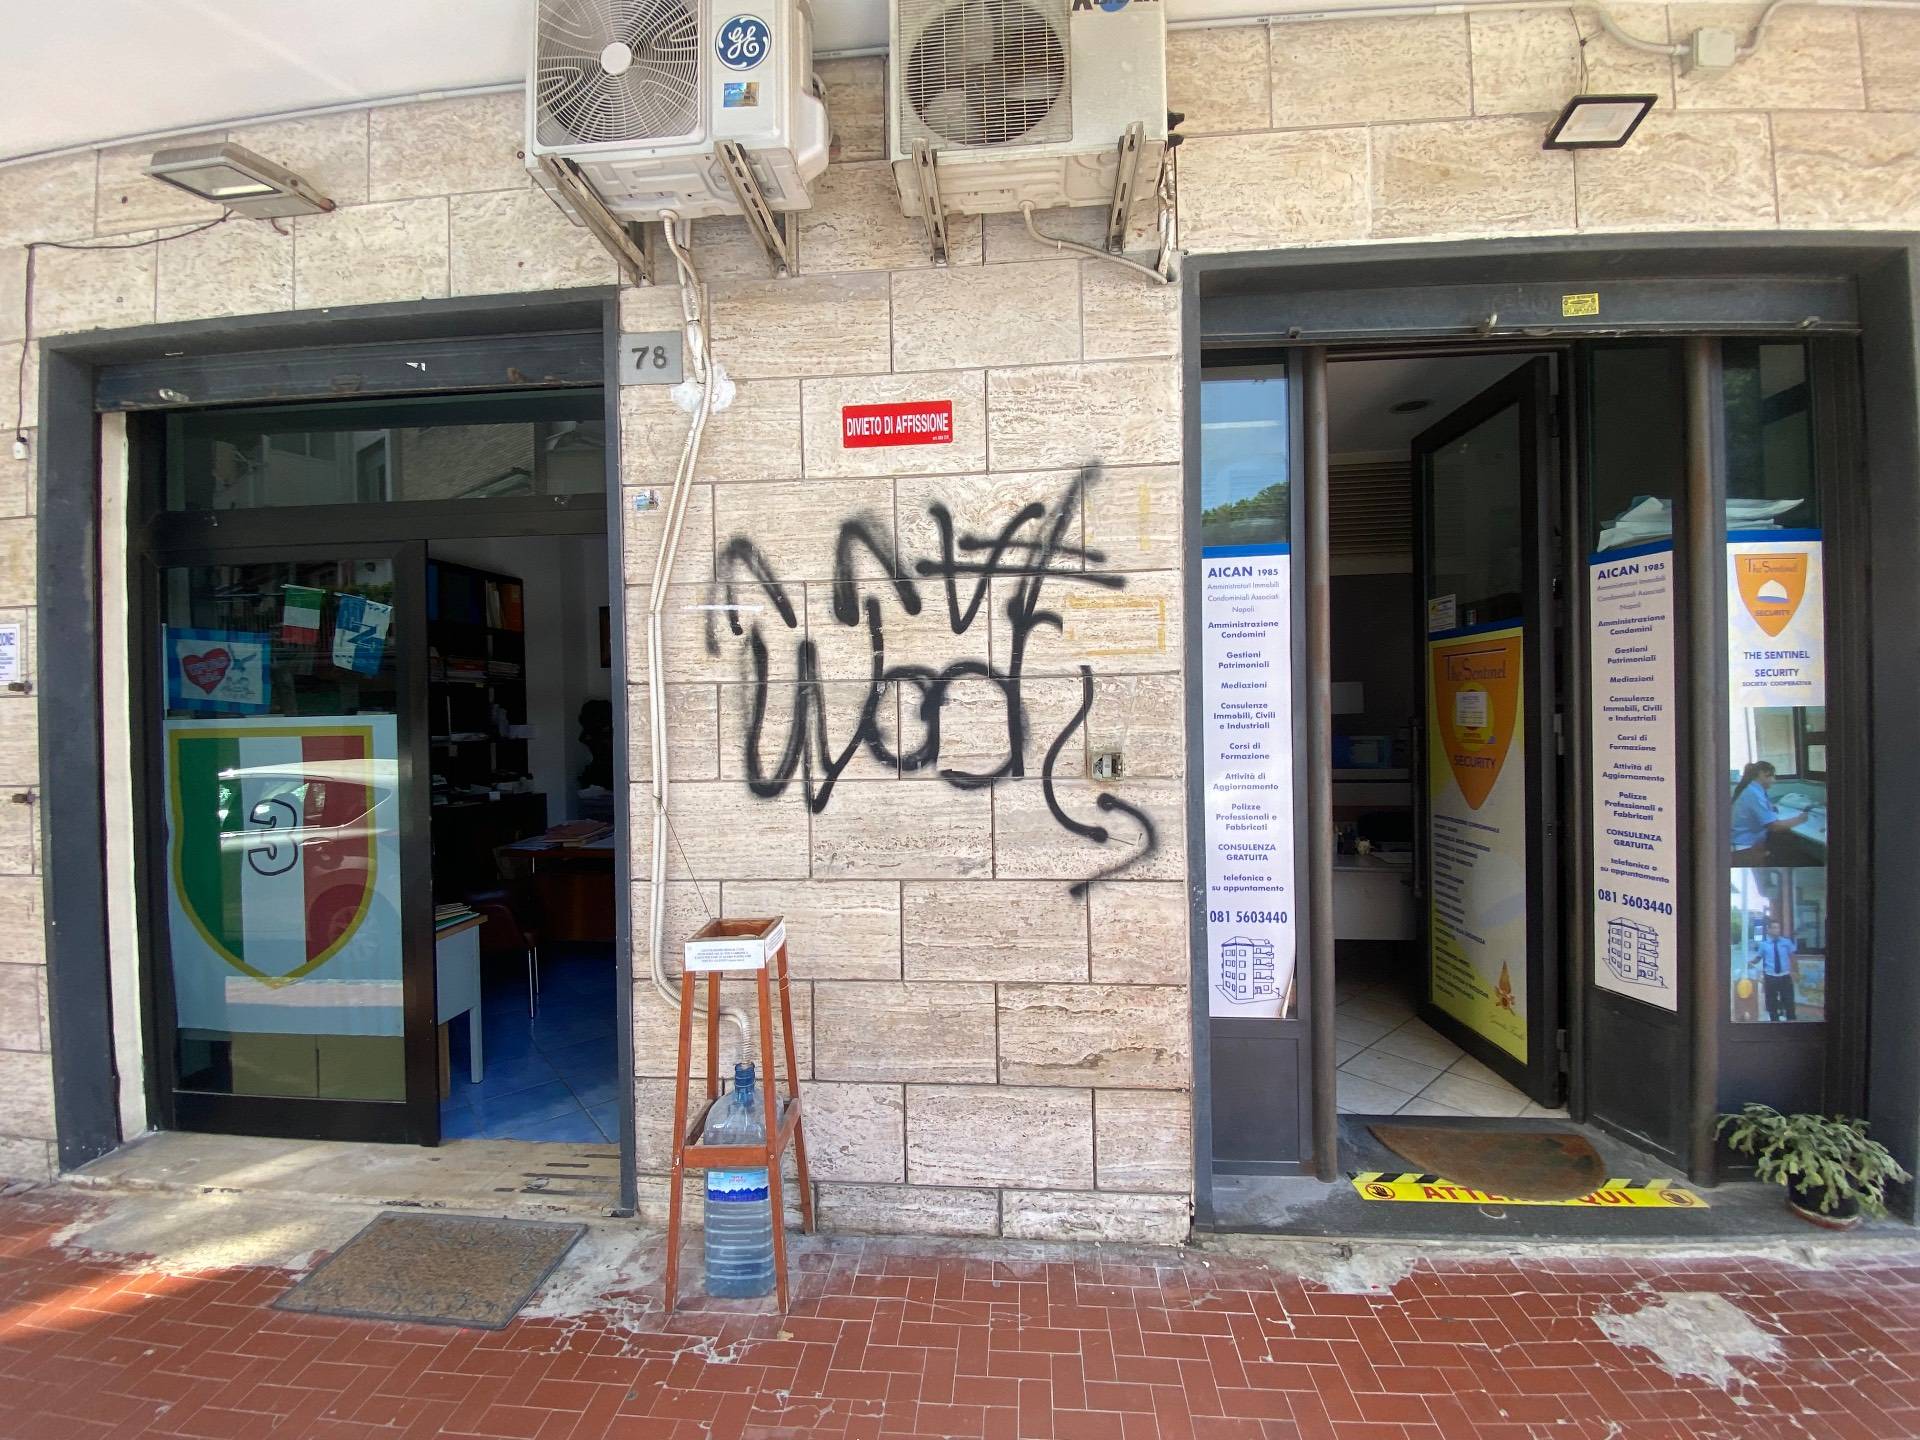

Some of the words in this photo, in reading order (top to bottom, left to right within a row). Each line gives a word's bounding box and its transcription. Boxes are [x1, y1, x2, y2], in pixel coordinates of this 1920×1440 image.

[631, 345, 667, 370] 78
[846, 417, 882, 437] DIVIETO
[884, 416, 894, 435] DI
[896, 412, 950, 434] AFFISSIONE
[1208, 566, 1253, 578] AICAN
[1257, 568, 1279, 576] 1985
[1598, 564, 1640, 580] AICAN
[1644, 562, 1665, 572] 1985
[1232, 605, 1255, 614] Napoli
[1208, 620, 1279, 629] Amministrazione
[1598, 615, 1666, 627] Amministrazione
[1610, 625, 1653, 635] Condomini
[1221, 631, 1266, 639] Condomini
[1615, 646, 1648, 654] Gestioni
[1226, 651, 1261, 659] Gestioni
[1607, 655, 1657, 664] Patrimoniali
[1744, 651, 1762, 660] THE
[1764, 650, 1811, 660] SENTINEL
[1218, 661, 1269, 669] Patrimoniali
[1754, 668, 1800, 678] SECURITY
[1610, 675, 1654, 683] Mediazioni
[1221, 681, 1268, 689] Mediazioni
[1221, 701, 1268, 710] Consulenze
[1603, 704, 1640, 712] Immobili,
[1642, 704, 1663, 712] Civili
[1213, 711, 1253, 720] Immobili,
[1255, 711, 1276, 719] Civili
[1615, 714, 1657, 722] Industriali
[1227, 722, 1270, 730] Industriali
[1229, 742, 1250, 750] Corsi
[1252, 742, 1261, 750] di
[1609, 743, 1656, 751] Formazione
[1220, 752, 1270, 760] Formazione
[1454, 754, 1497, 769] SECURITY
[1257, 772, 1266, 780] di
[1602, 771, 1665, 782] Aggiornamento
[1213, 783, 1279, 792] Aggiornamento
[1619, 791, 1647, 801] Polizze
[1604, 799, 1656, 811] Professionali
[1216, 813, 1269, 821] Professionali
[1613, 810, 1654, 821] Fabbricati
[1225, 823, 1268, 831] Fabbricati
[1606, 828, 1662, 842] CONSULENZA
[1218, 843, 1276, 851] CONSULENZA
[1613, 839, 1655, 851] GRATUITA
[1610, 858, 1650, 870] telefonica
[1223, 873, 1264, 881] telefonica
[1610, 867, 1670, 884] appuntamento
[1223, 885, 1284, 893] appuntamento
[1598, 888, 1617, 903] 081
[1621, 893, 1673, 916] 5603440
[1209, 910, 1230, 923] 081
[1236, 910, 1288, 924] 5603440
